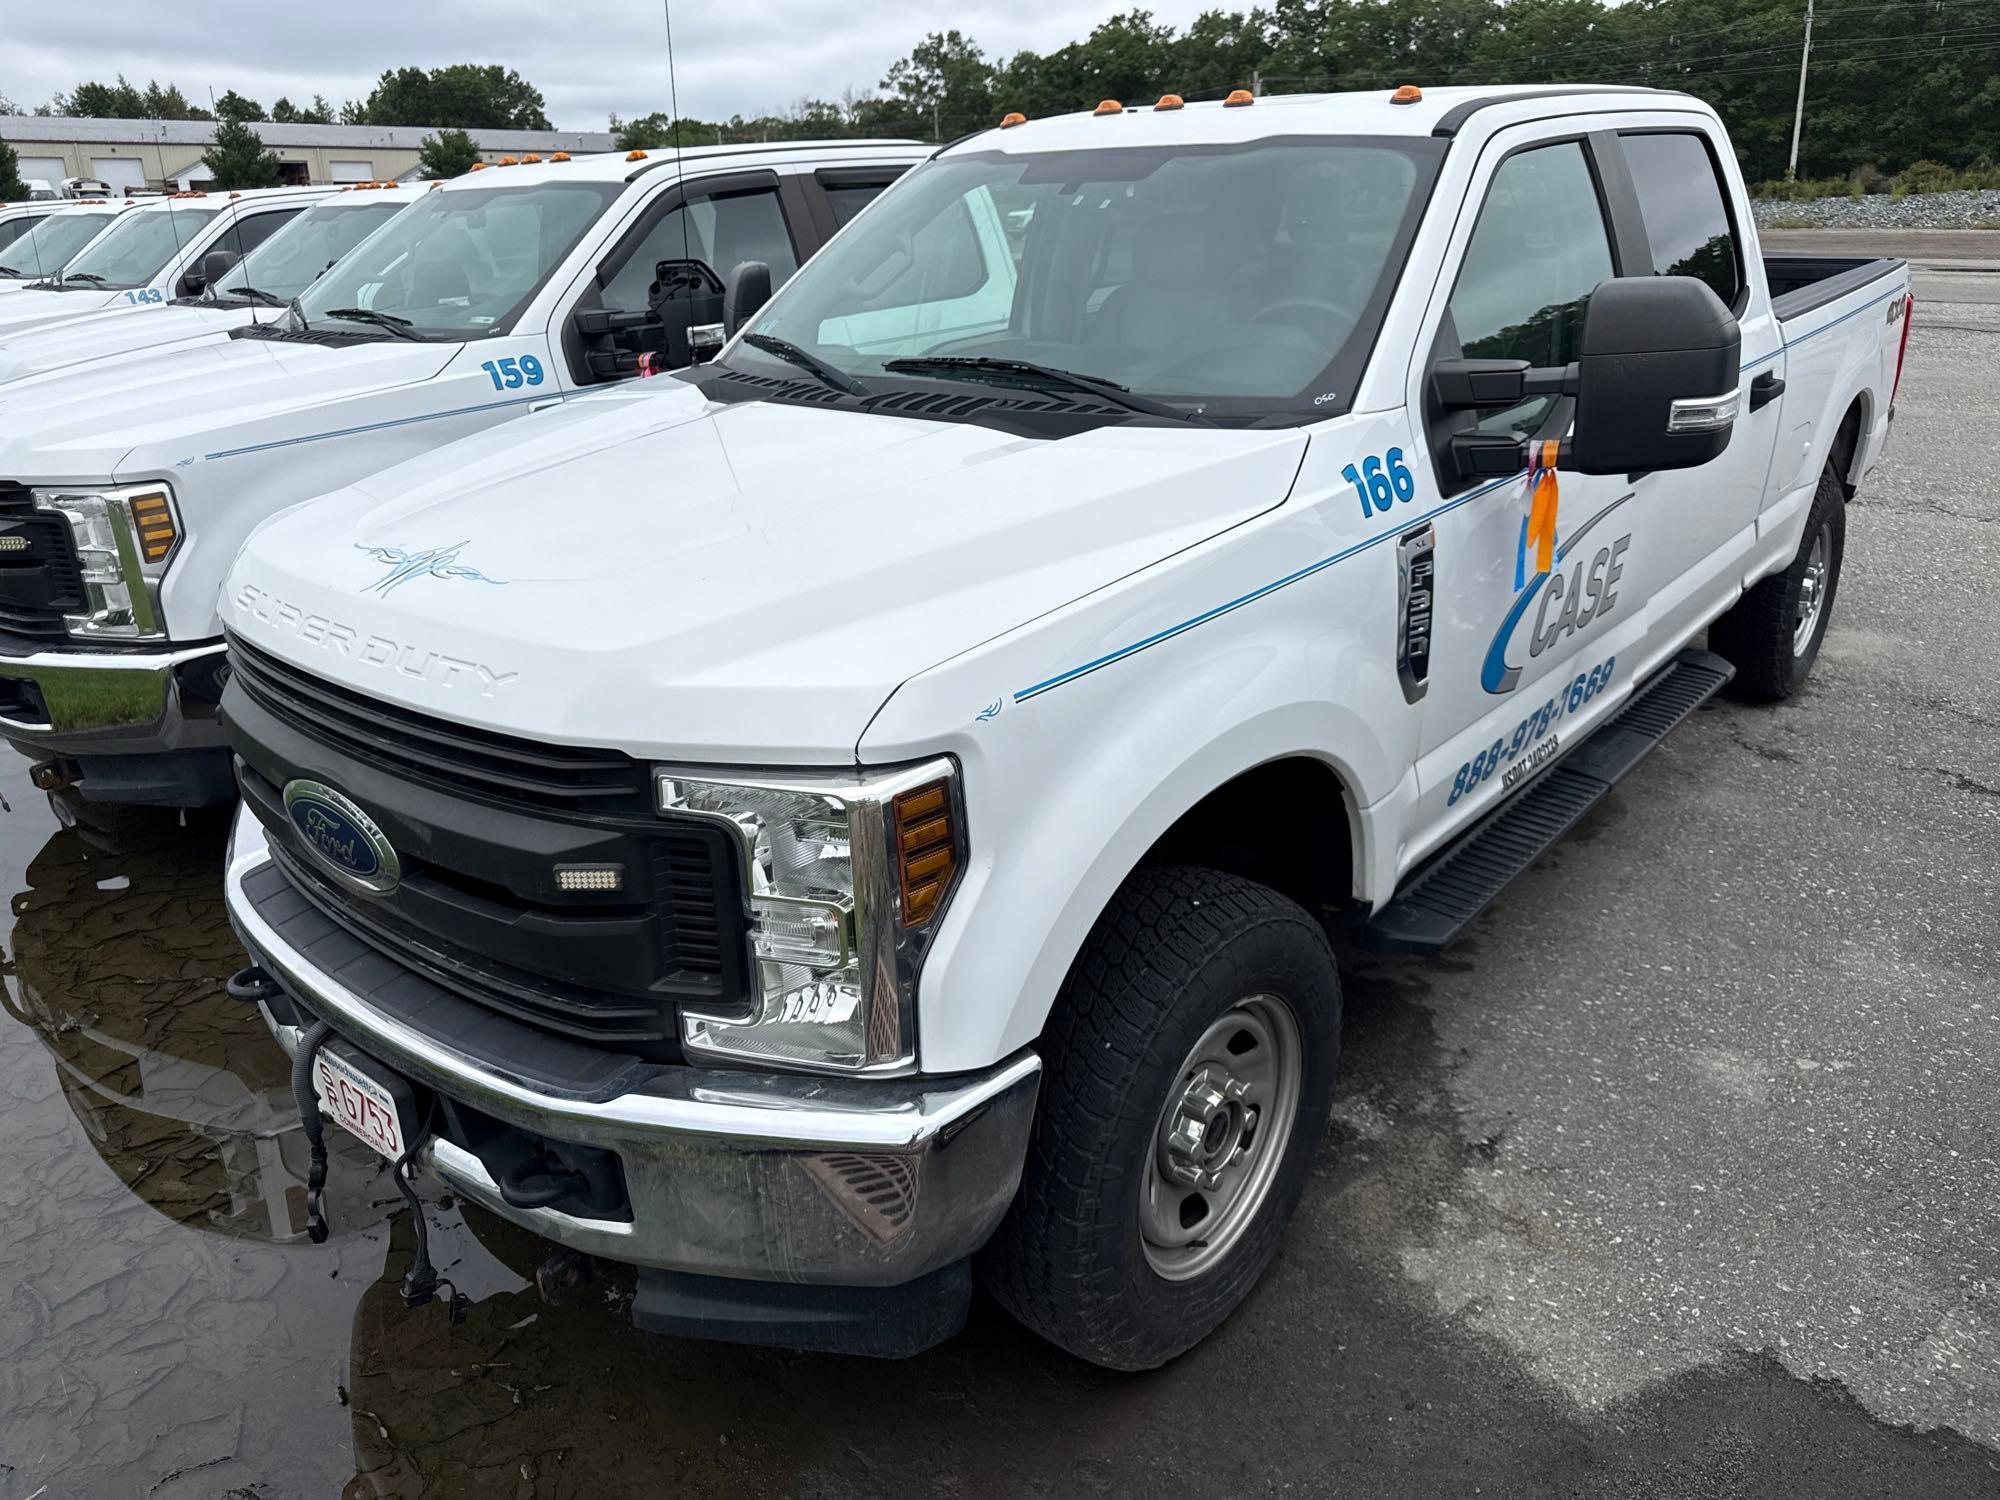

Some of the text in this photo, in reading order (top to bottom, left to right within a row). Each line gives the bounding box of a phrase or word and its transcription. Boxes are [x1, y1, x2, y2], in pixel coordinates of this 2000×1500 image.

[125, 288, 163, 305] 143
[481, 354, 544, 391] 159
[1341, 447, 1414, 518] 166
[1530, 533, 1631, 658] CASE
[236, 583, 518, 698] SUPER DUTY
[1447, 656, 1615, 807] 888-978-7669
[304, 806, 359, 868] Ford
[340, 1079, 397, 1152] G753
